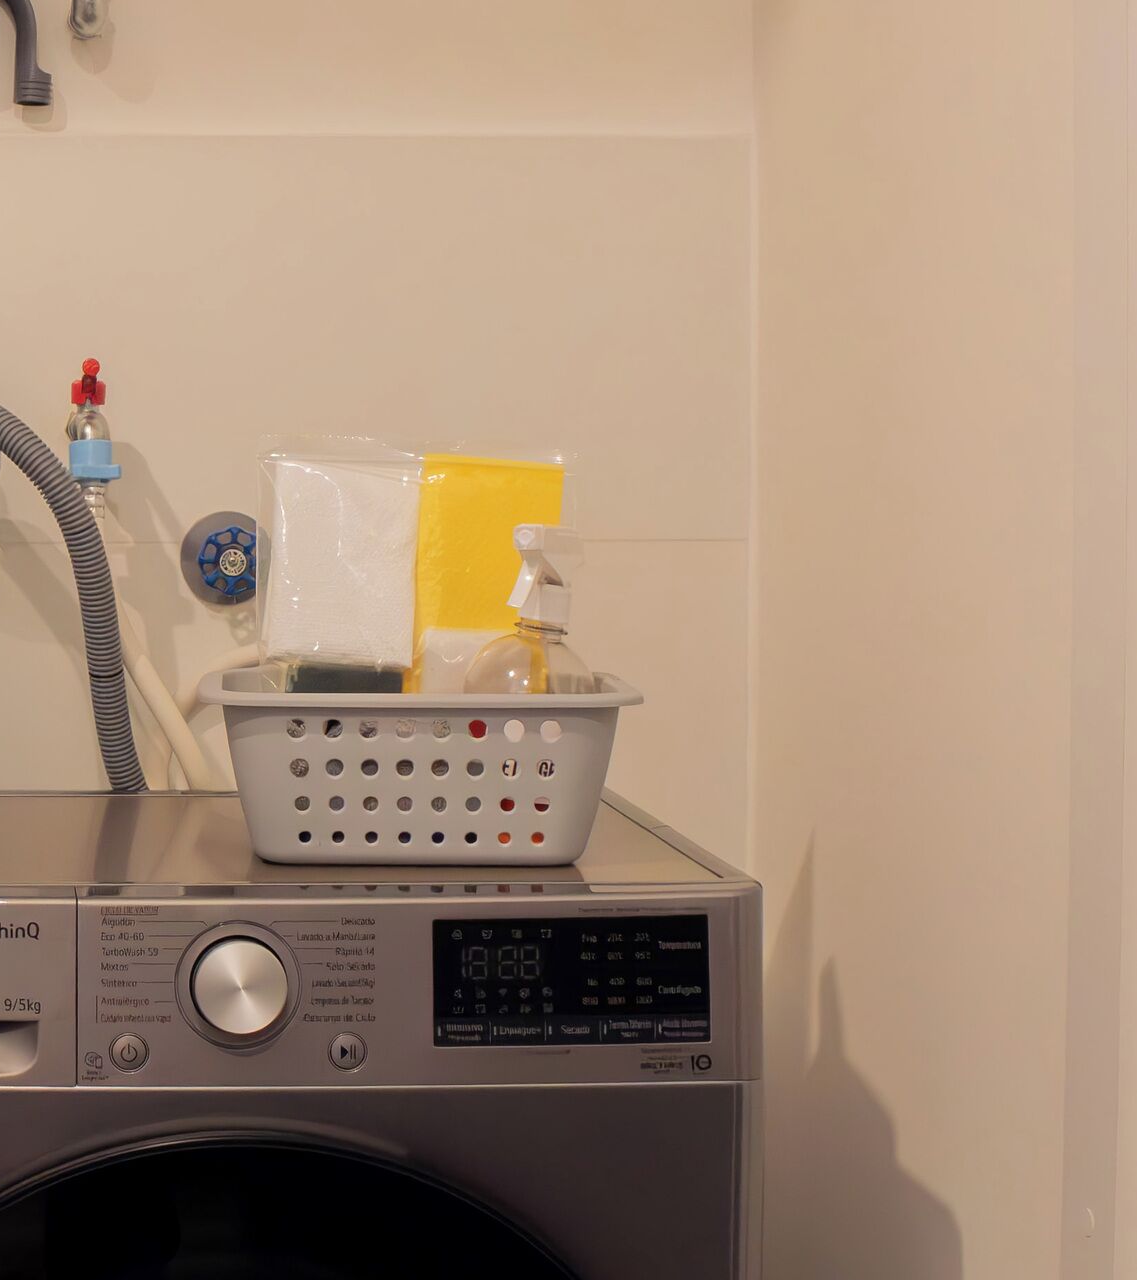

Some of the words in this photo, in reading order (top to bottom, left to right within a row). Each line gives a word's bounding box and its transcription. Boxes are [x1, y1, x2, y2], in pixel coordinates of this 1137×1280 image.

[102, 947, 146, 957] TurboWash
[100, 962, 129, 971] Mixtos
[4, 998, 41, 1014] 9/5kg
